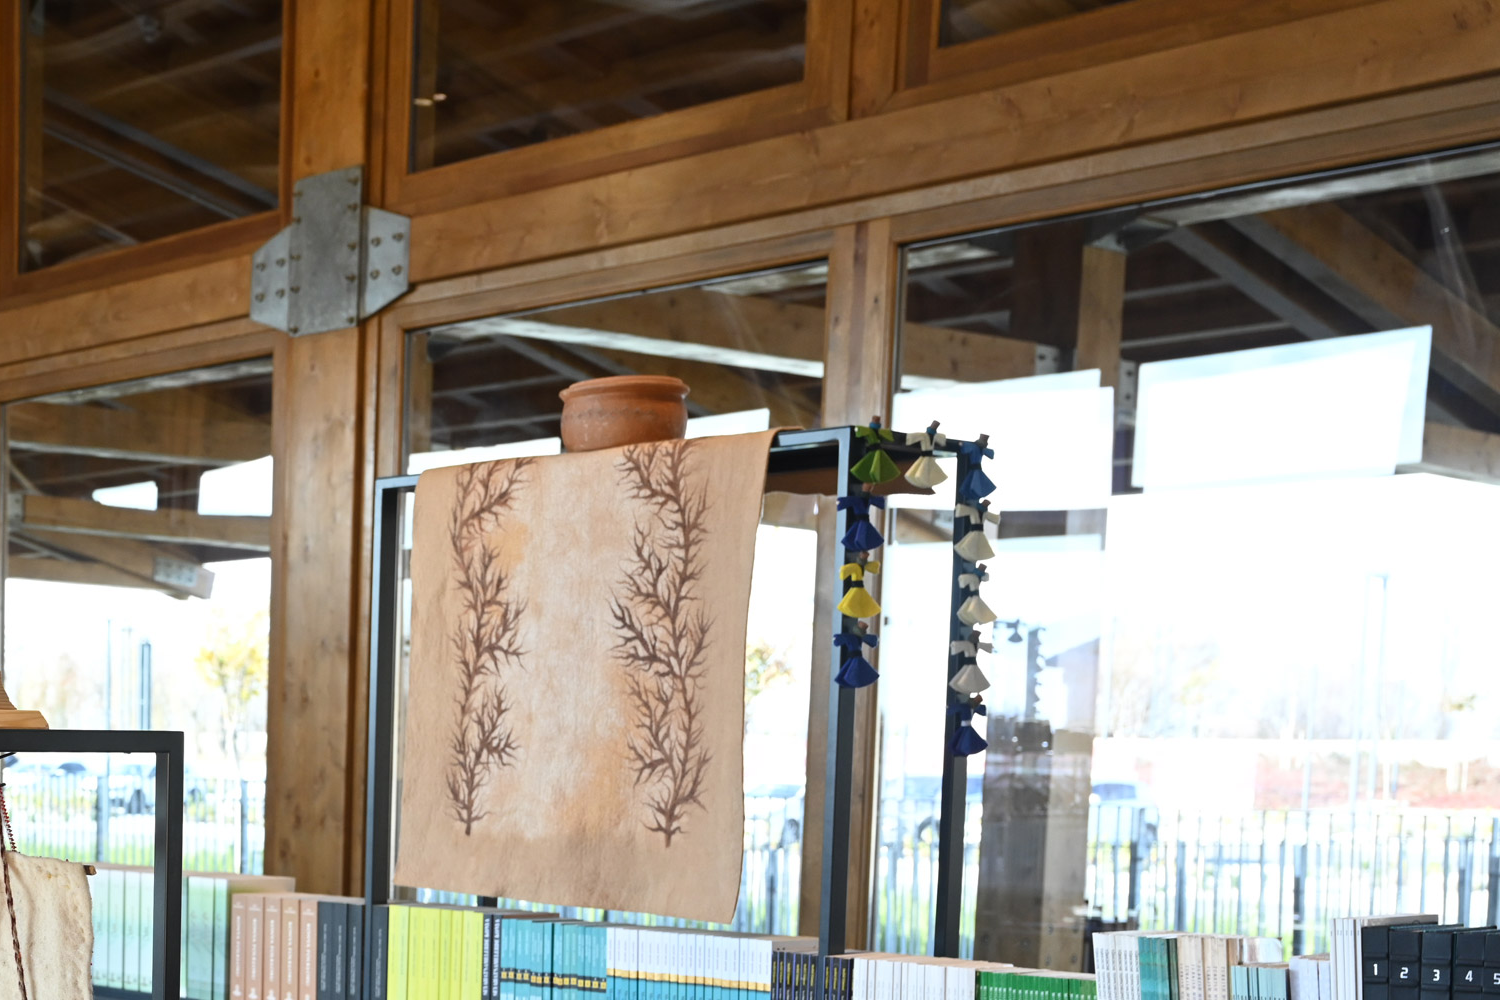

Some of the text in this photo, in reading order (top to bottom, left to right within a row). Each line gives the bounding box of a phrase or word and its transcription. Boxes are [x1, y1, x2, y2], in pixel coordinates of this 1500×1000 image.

[1373, 964, 1378, 976] 1
[1400, 967, 1409, 979] 2
[1432, 970, 1440, 982] 3
[1465, 970, 1473, 982] 4
[1494, 973, 1500, 984] 5
